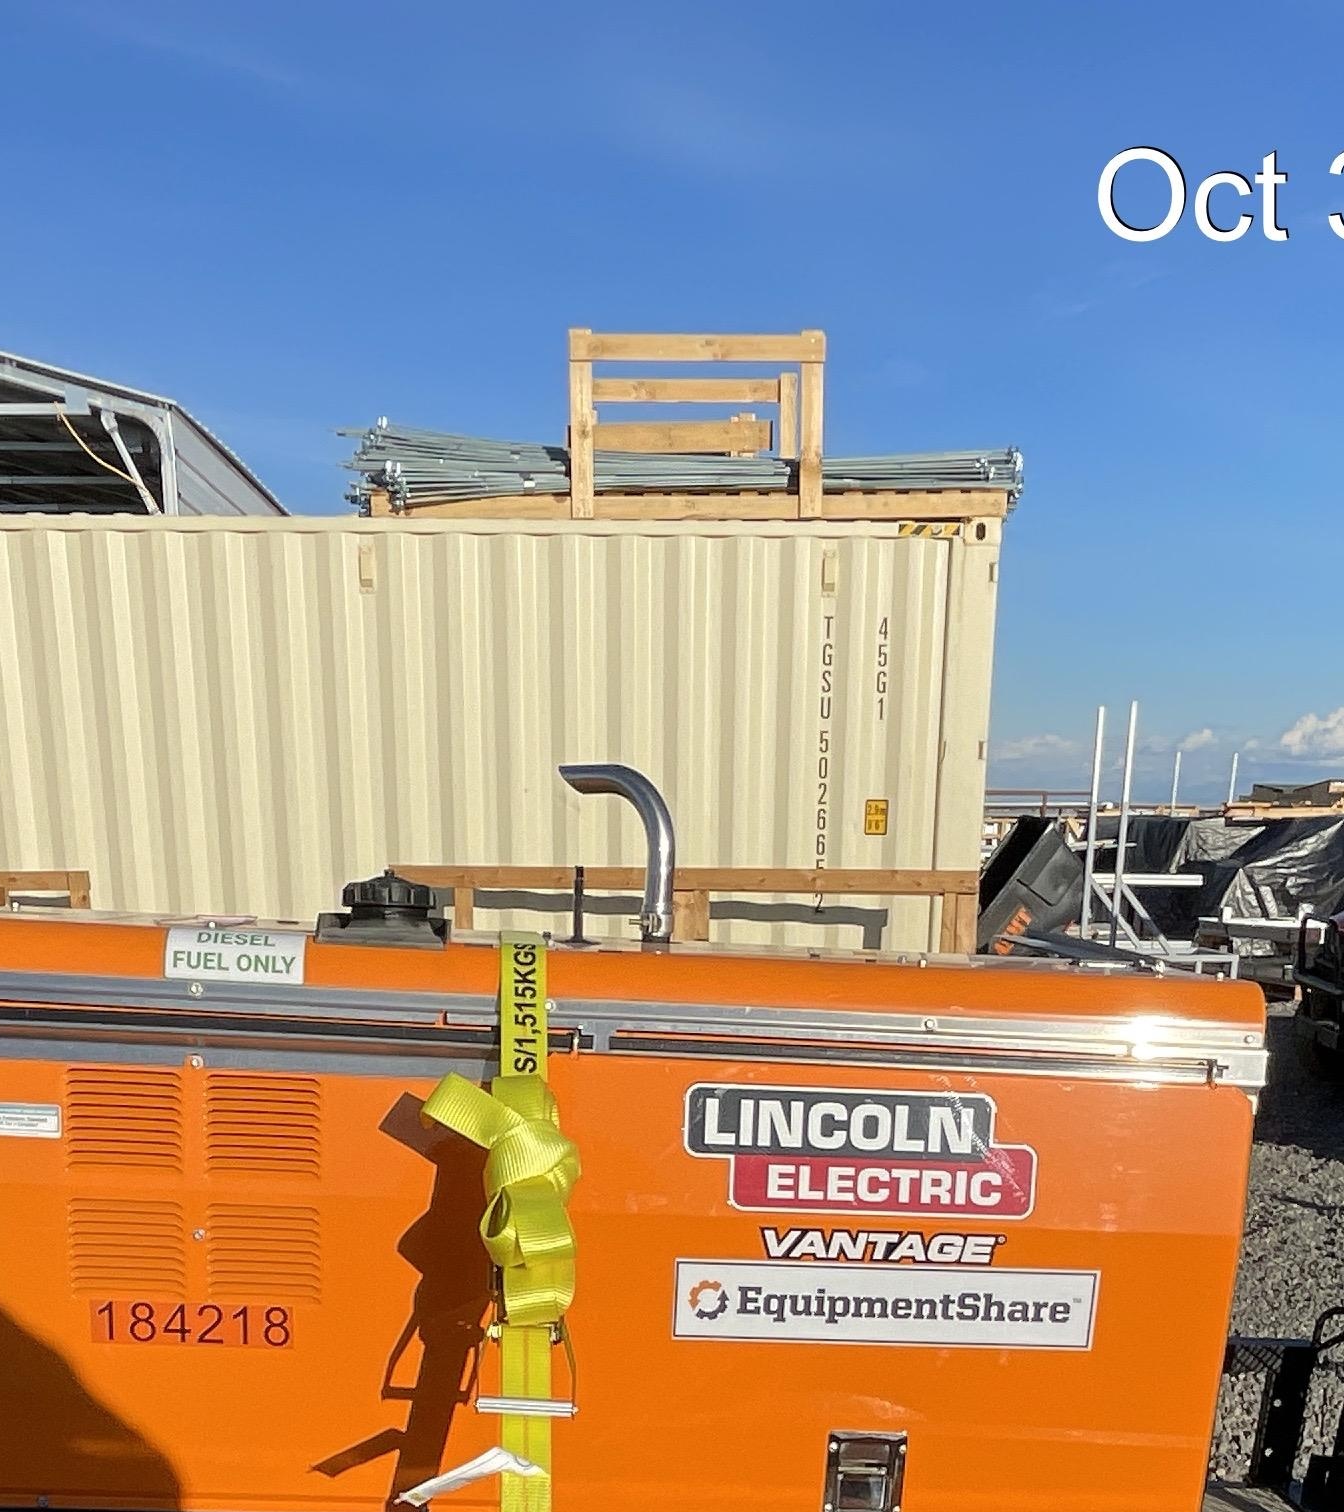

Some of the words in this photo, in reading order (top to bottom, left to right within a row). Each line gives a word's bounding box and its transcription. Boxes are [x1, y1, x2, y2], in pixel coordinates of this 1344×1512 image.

[819, 616, 834, 720] TGSU
[876, 617, 889, 720] 45G1
[196, 931, 277, 948] DIESEL
[171, 950, 230, 973] FUEL
[235, 953, 297, 975] ONLY
[703, 1097, 975, 1154] LINCOLN
[766, 1164, 1003, 1207] ELECTRIC
[762, 1228, 996, 1265] VANTAGE
[96, 1301, 291, 1347] 184218
[737, 1286, 1072, 1325] EquipmentShare
